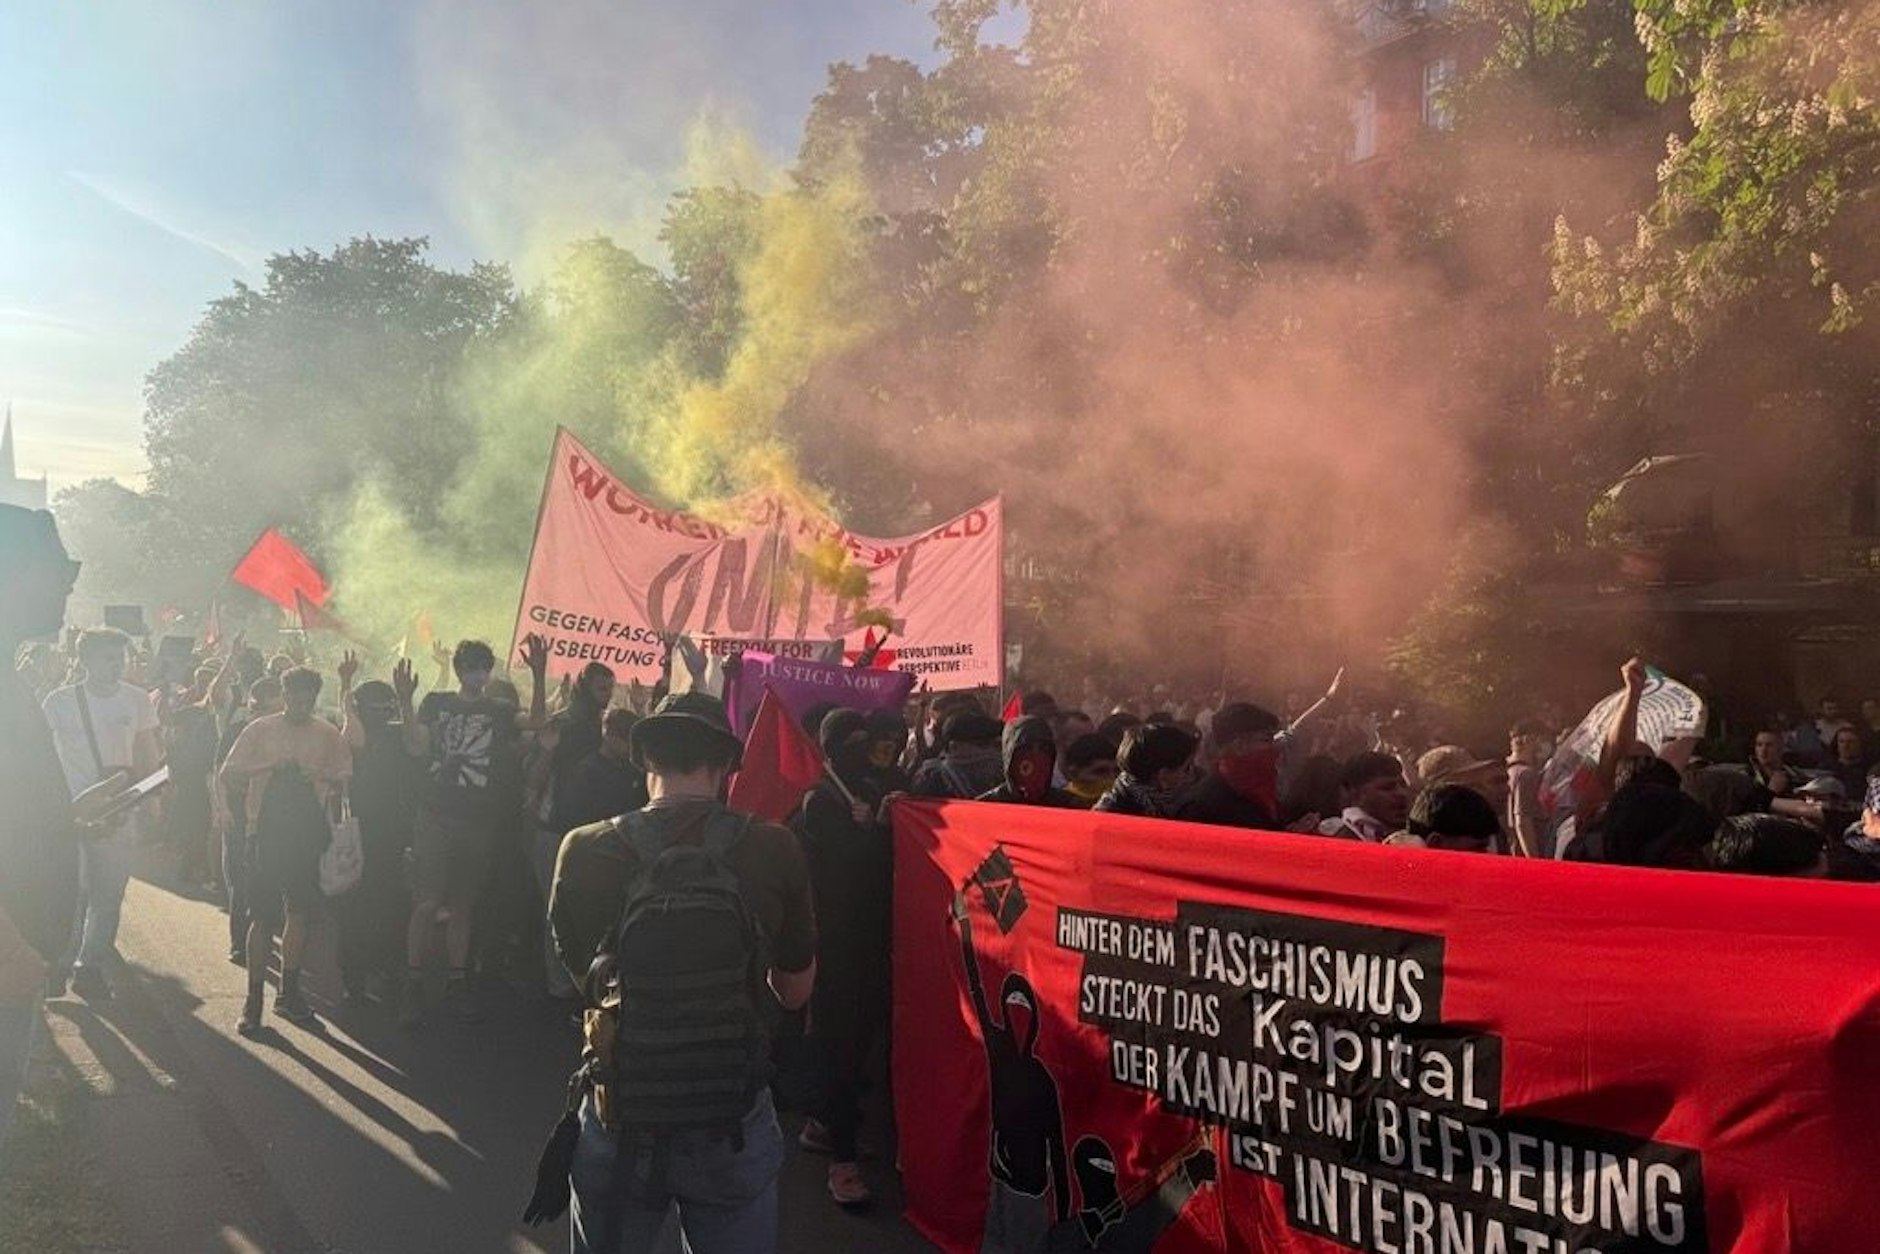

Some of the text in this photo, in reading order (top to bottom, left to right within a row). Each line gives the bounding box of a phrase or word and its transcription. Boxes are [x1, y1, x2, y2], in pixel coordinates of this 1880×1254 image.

[529, 605, 666, 647] GEGEN FASCH
[547, 637, 656, 667] SBEUTUNG
[782, 642, 813, 659] FOR
[759, 661, 883, 690] JUSTICE NOW
[1058, 913, 1425, 1024] HINTER DEM FASCHISMUS
[1082, 974, 1164, 1025] STECKT
[1173, 988, 1221, 1037] DAS
[1113, 1040, 1685, 1246] DER KAMPF UM BEFREIUNG
[1232, 1133, 1282, 1177] IST
